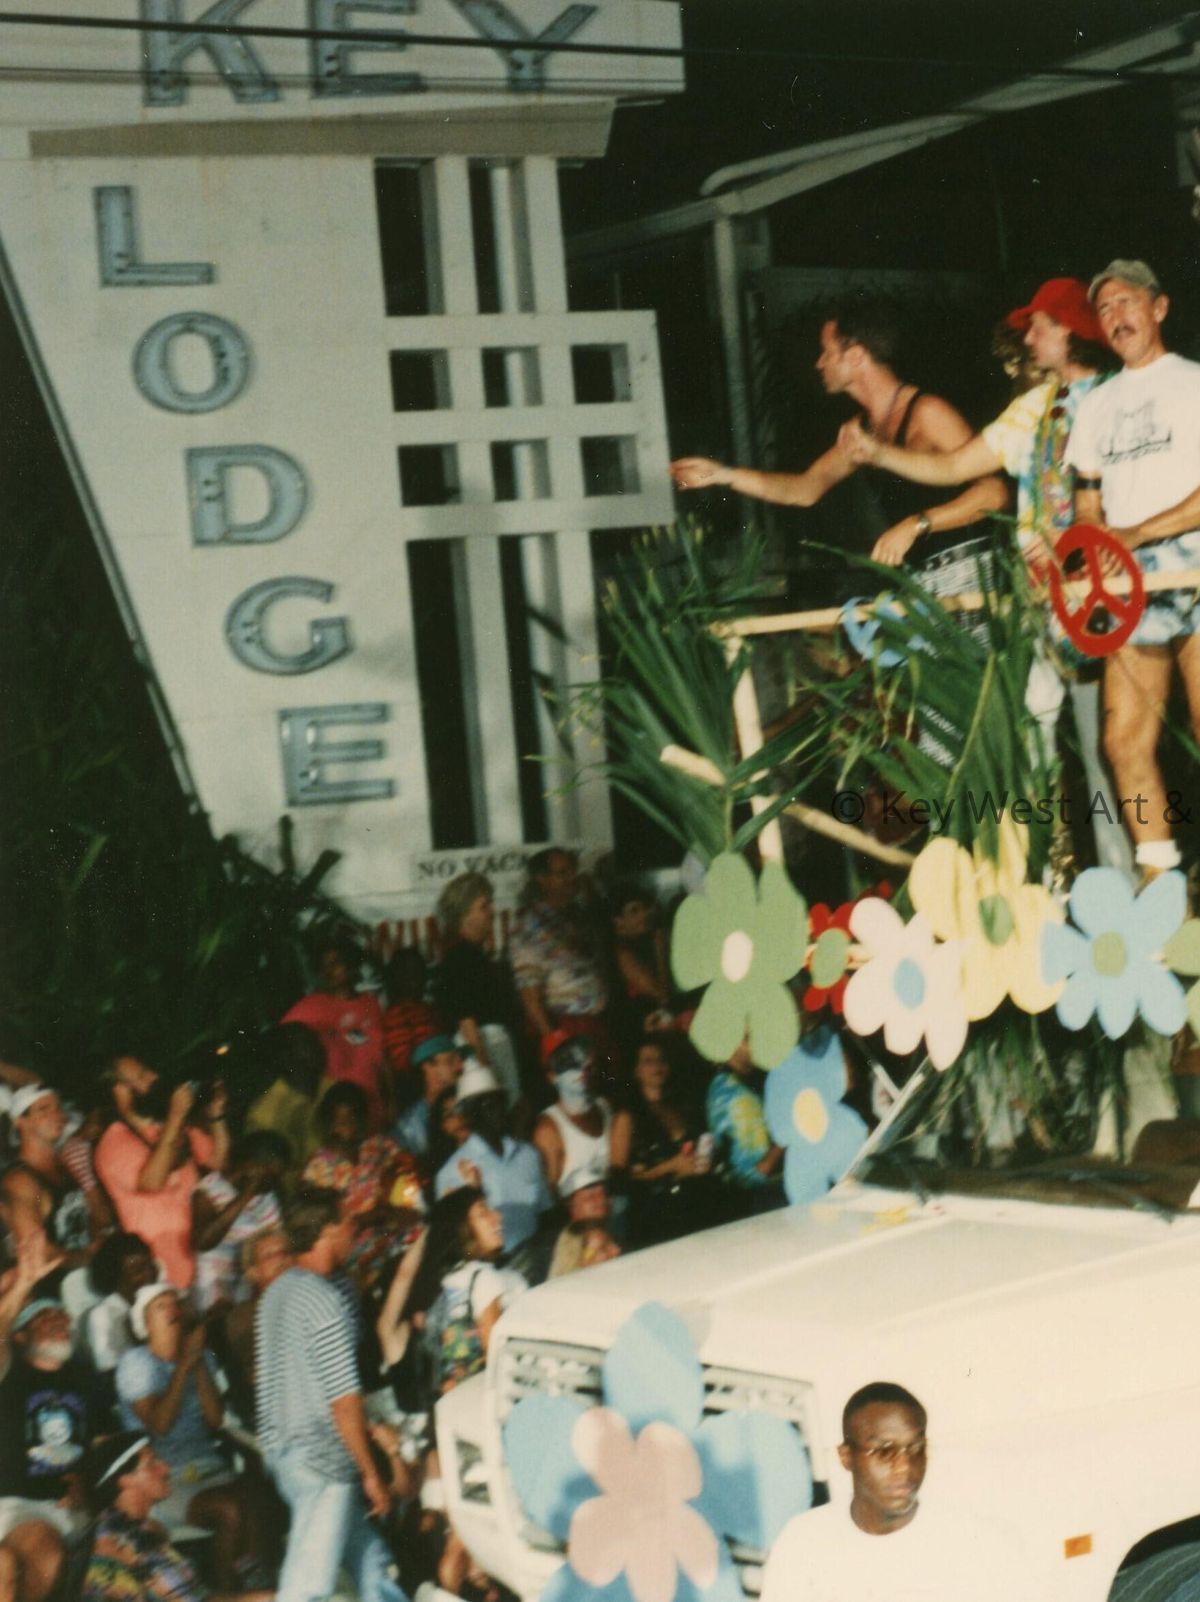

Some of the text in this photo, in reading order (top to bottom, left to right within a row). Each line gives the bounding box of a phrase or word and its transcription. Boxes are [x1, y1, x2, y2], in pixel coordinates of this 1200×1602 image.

[142, 0, 598, 107] KEY
[92, 184, 396, 807] LODGE
[417, 857, 457, 879] NO
